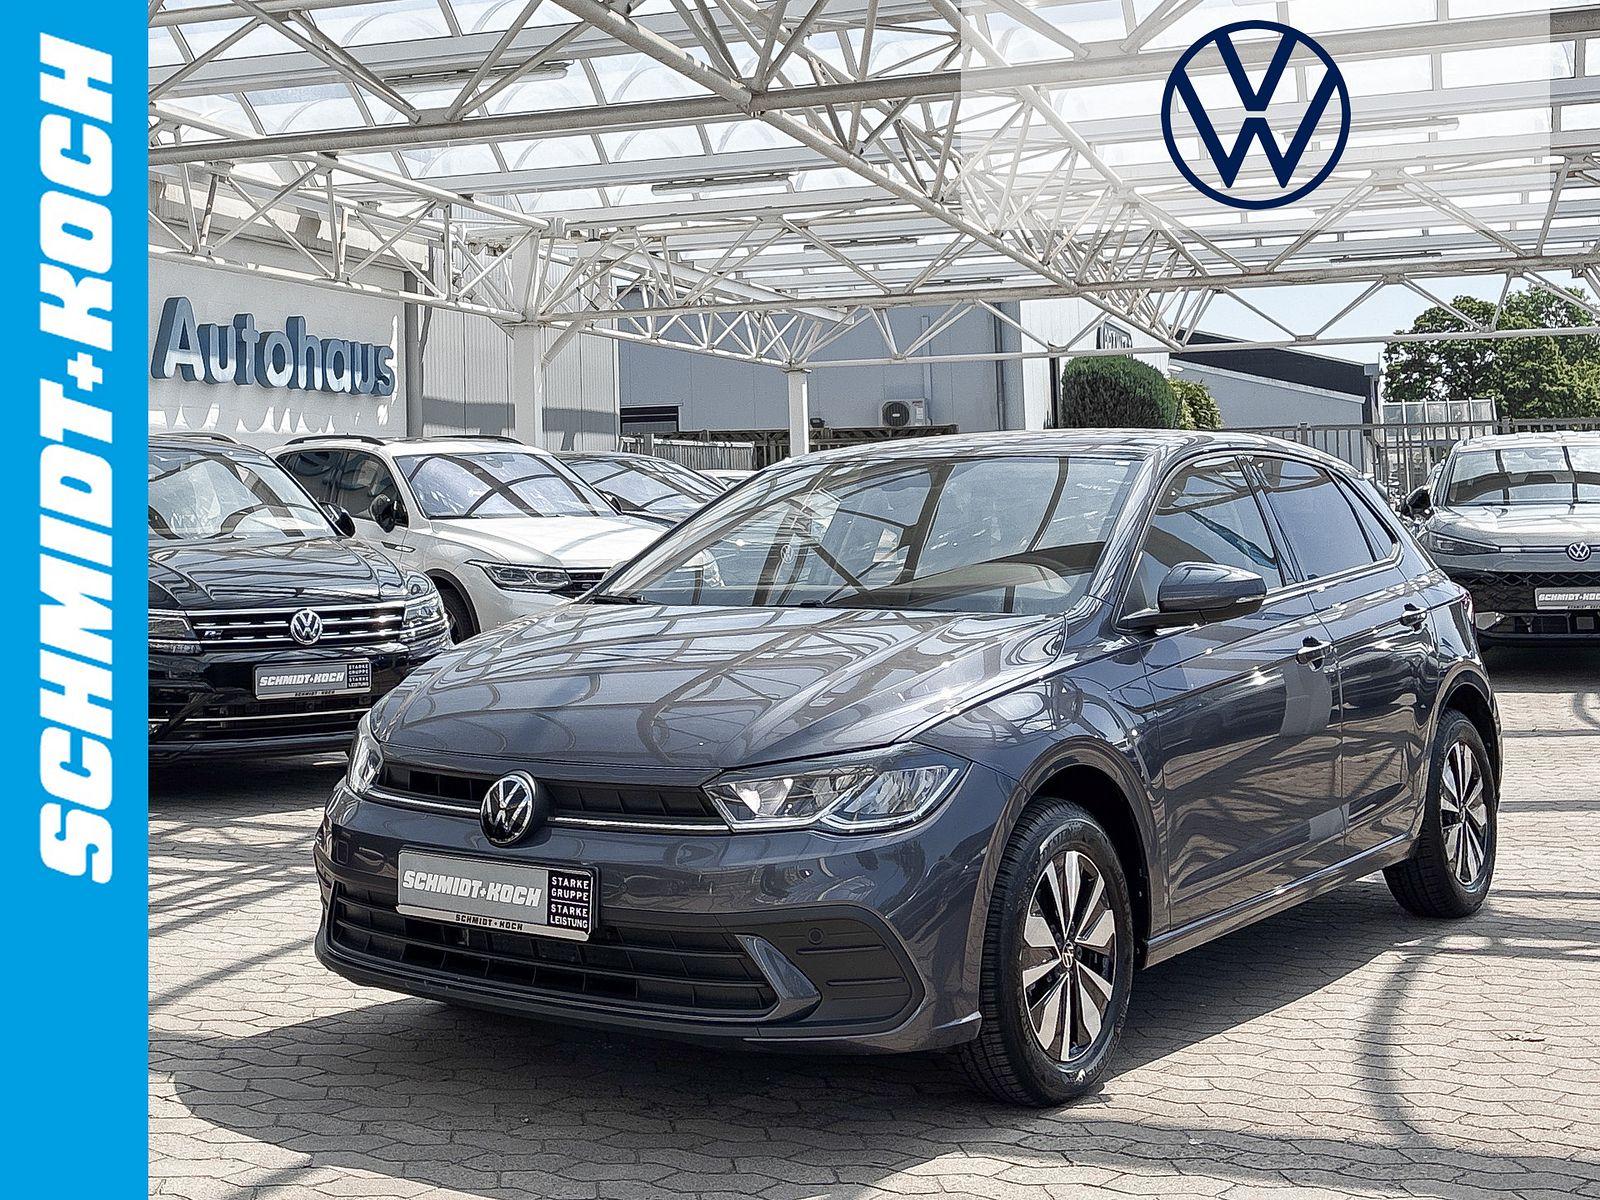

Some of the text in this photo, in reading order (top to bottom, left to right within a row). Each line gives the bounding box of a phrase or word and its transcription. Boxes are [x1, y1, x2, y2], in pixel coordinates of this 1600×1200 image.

[151, 296, 395, 396] Autohaus
[259, 672, 345, 687] SCHMIDT+KOCH
[402, 869, 542, 907] SCHMIDT+KOCH
[551, 875, 590, 890] STARKE
[551, 887, 589, 901] GRUPPE
[550, 903, 588, 918] STARKE
[550, 914, 588, 929] LEISTUNG
